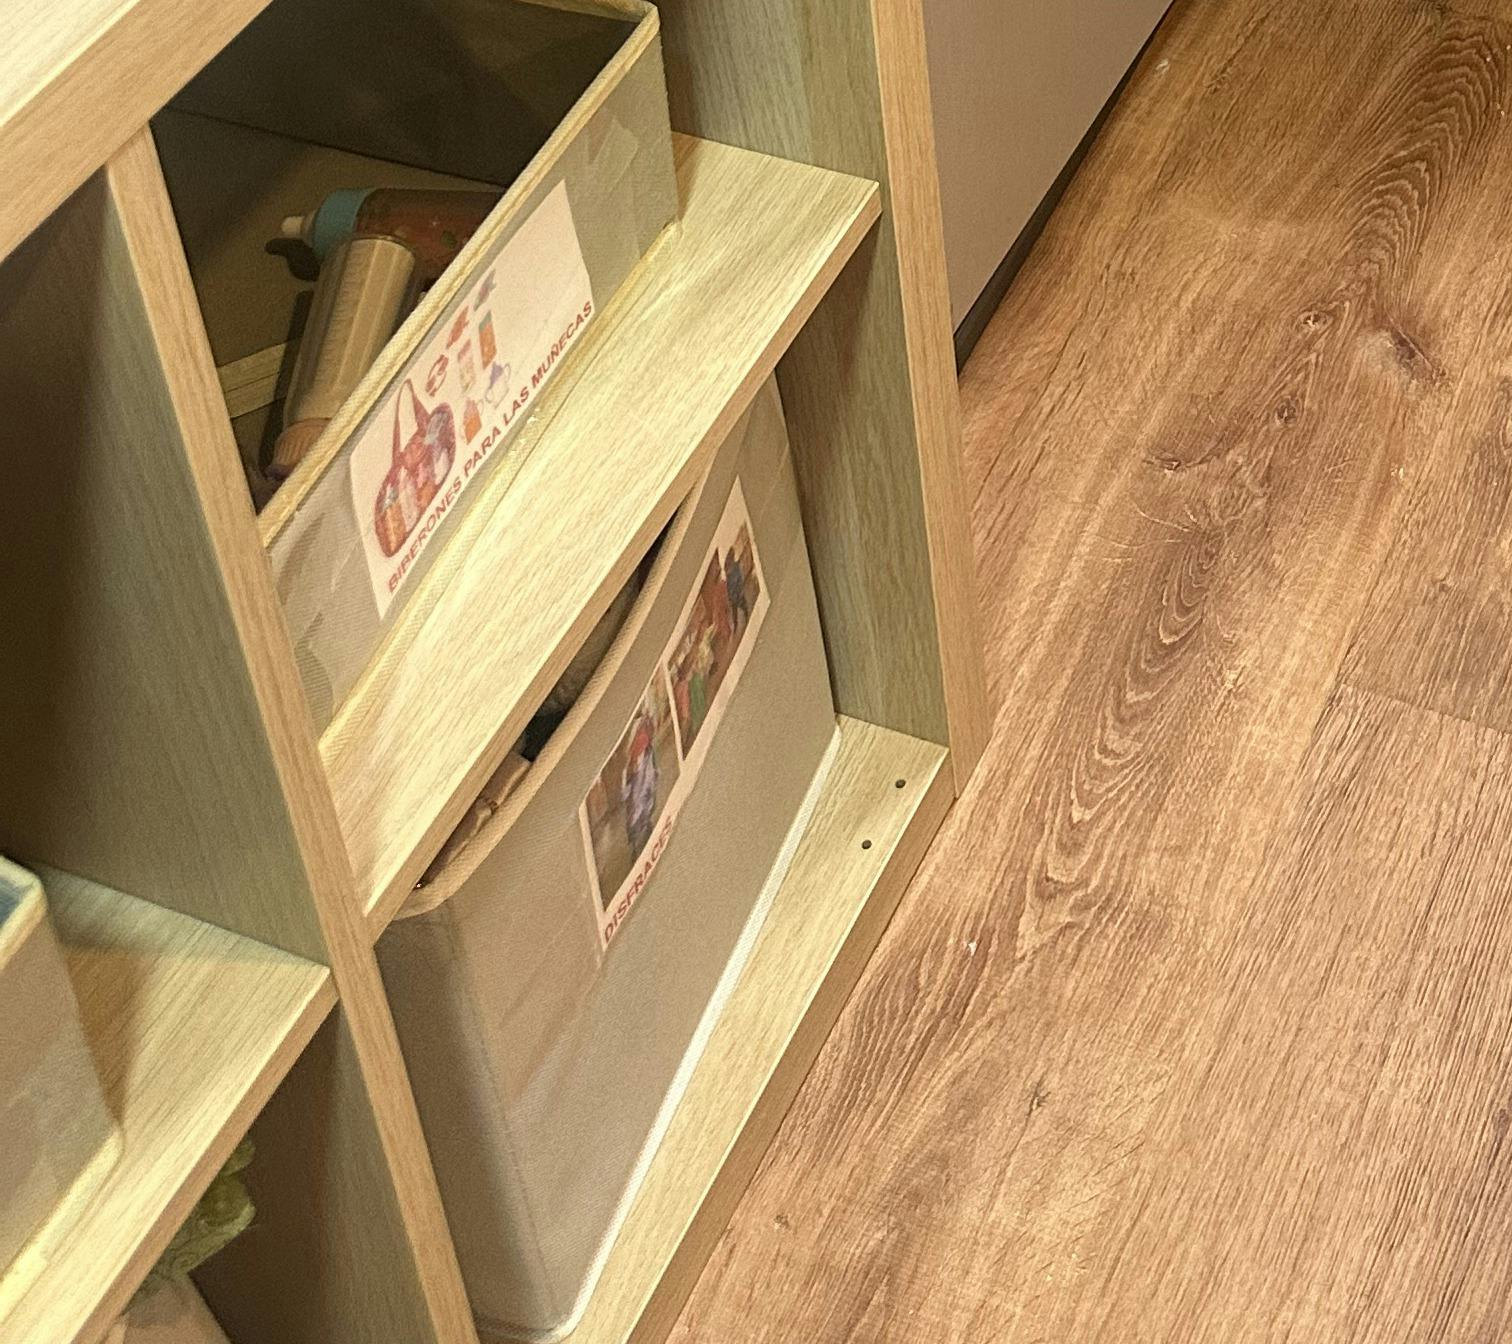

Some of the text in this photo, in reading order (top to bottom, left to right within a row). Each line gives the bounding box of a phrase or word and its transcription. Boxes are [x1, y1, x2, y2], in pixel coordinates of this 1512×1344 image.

[387, 300, 593, 593] BIBERONES PARA LAS MUÑECAS
[603, 814, 674, 944] DISFRACES
